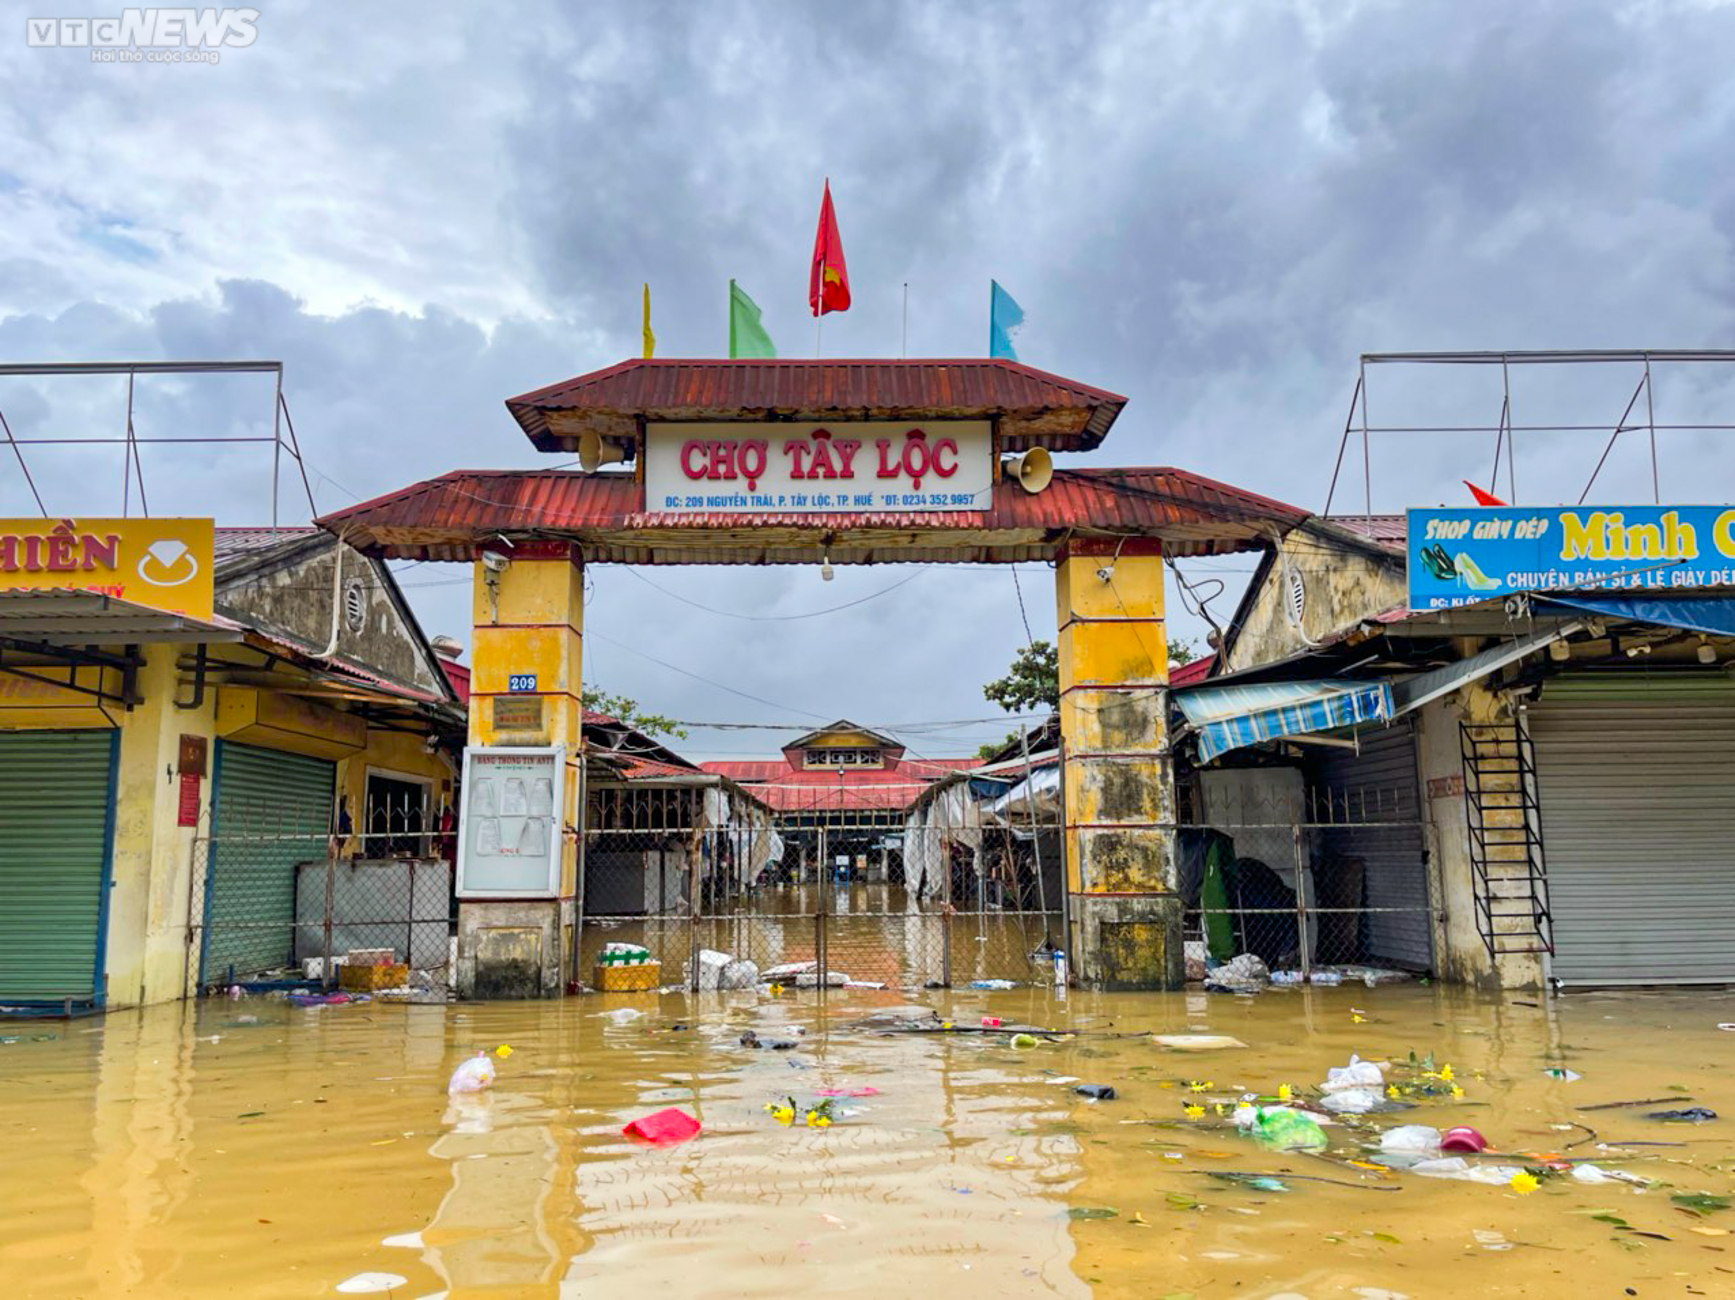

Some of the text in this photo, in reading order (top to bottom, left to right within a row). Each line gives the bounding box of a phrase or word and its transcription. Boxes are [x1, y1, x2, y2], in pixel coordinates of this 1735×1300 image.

[680, 428, 959, 492] CHỢ TÂY LỘC
[665, 496, 683, 508] ĐC:
[685, 496, 704, 508] 209
[706, 492, 747, 507] NGUYỄN
[750, 494, 776, 508] TRÃI,
[778, 495, 787, 507] P.
[791, 493, 808, 507] TÂY
[811, 492, 835, 509] LỘC,
[836, 494, 850, 507] TP.
[853, 491, 873, 506] HUẾ
[902, 494, 927, 506] 0234
[929, 494, 948, 506] 352
[1425, 516, 1549, 540] SHOP GIÀY DÉP
[1559, 511, 1699, 560] Minh
[1506, 568, 1570, 588] CHUYÊN
[1574, 567, 1606, 588] BÁN
[1630, 570, 1642, 587] &
[1671, 566, 1706, 587] GIÀY
[511, 677, 536, 690] 209
